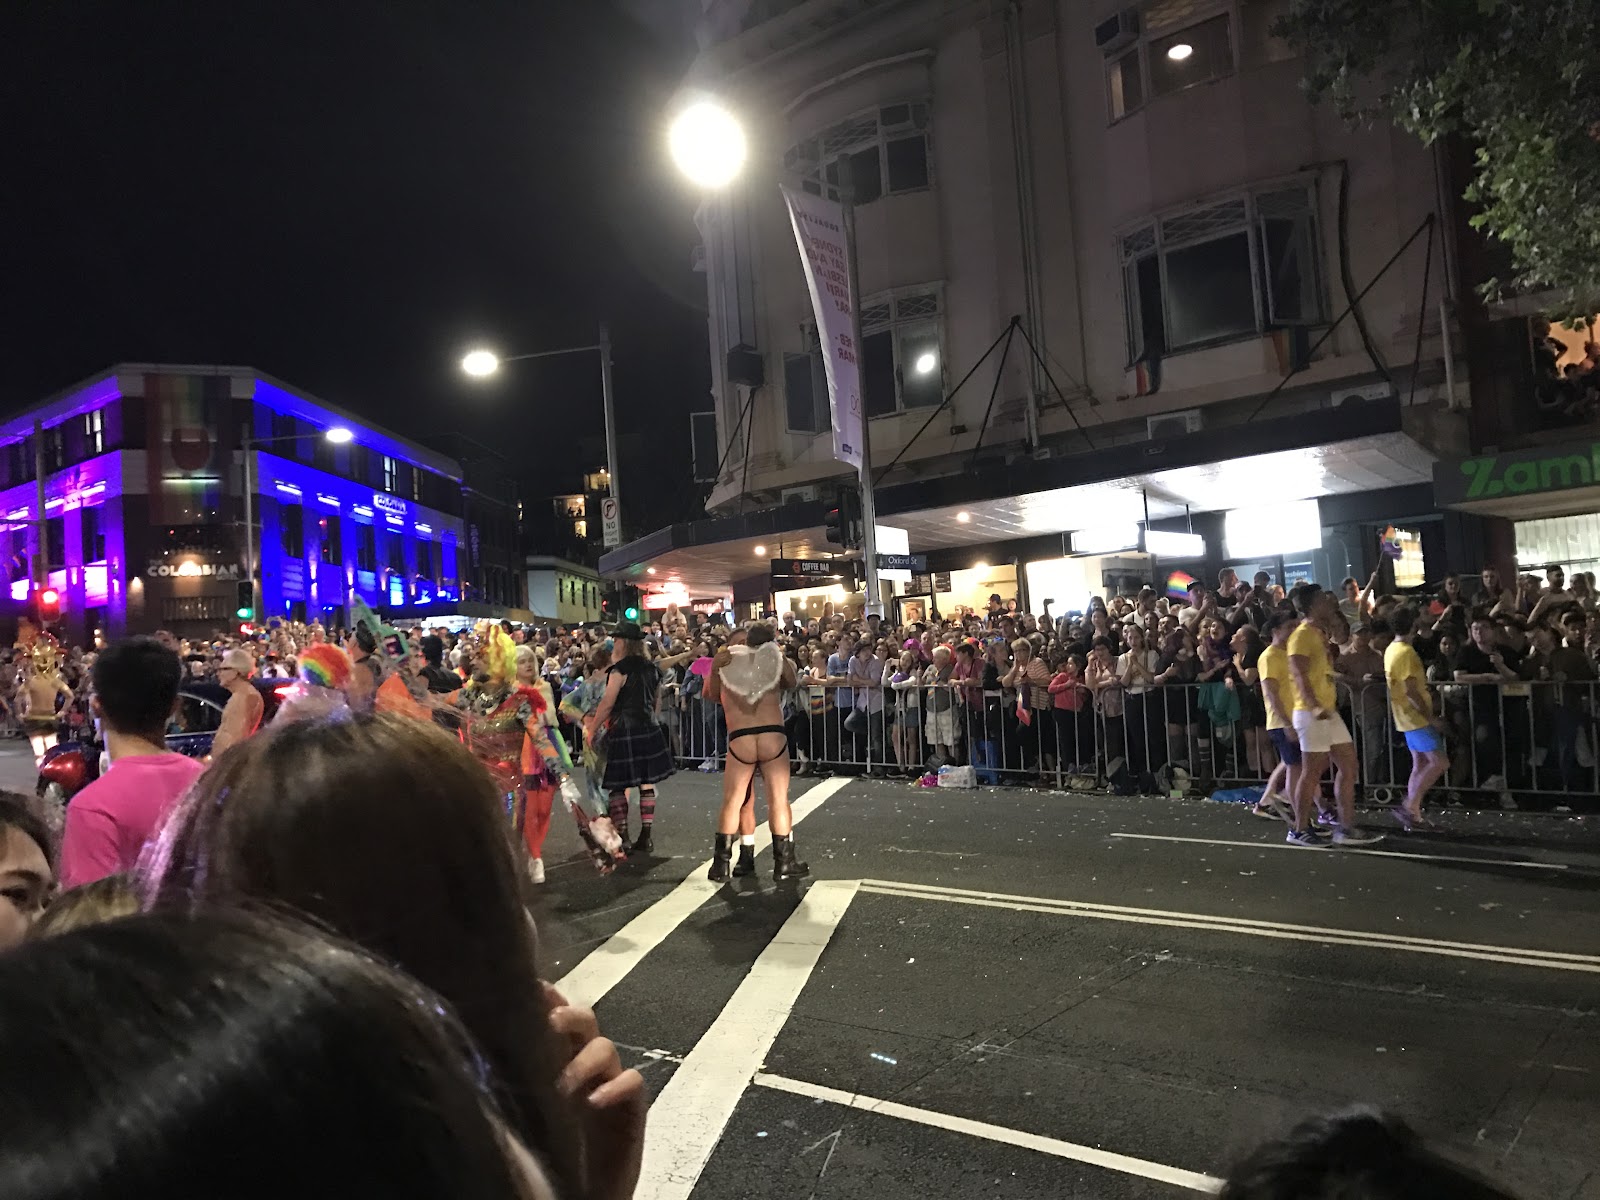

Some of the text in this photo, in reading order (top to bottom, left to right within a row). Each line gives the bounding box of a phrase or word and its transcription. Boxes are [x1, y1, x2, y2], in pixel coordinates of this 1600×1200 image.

[605, 521, 616, 529] NO
[888, 556, 918, 565] Oxford St
[147, 562, 239, 577] COLBIAN
[801, 562, 830, 572] COFFEE BAR
